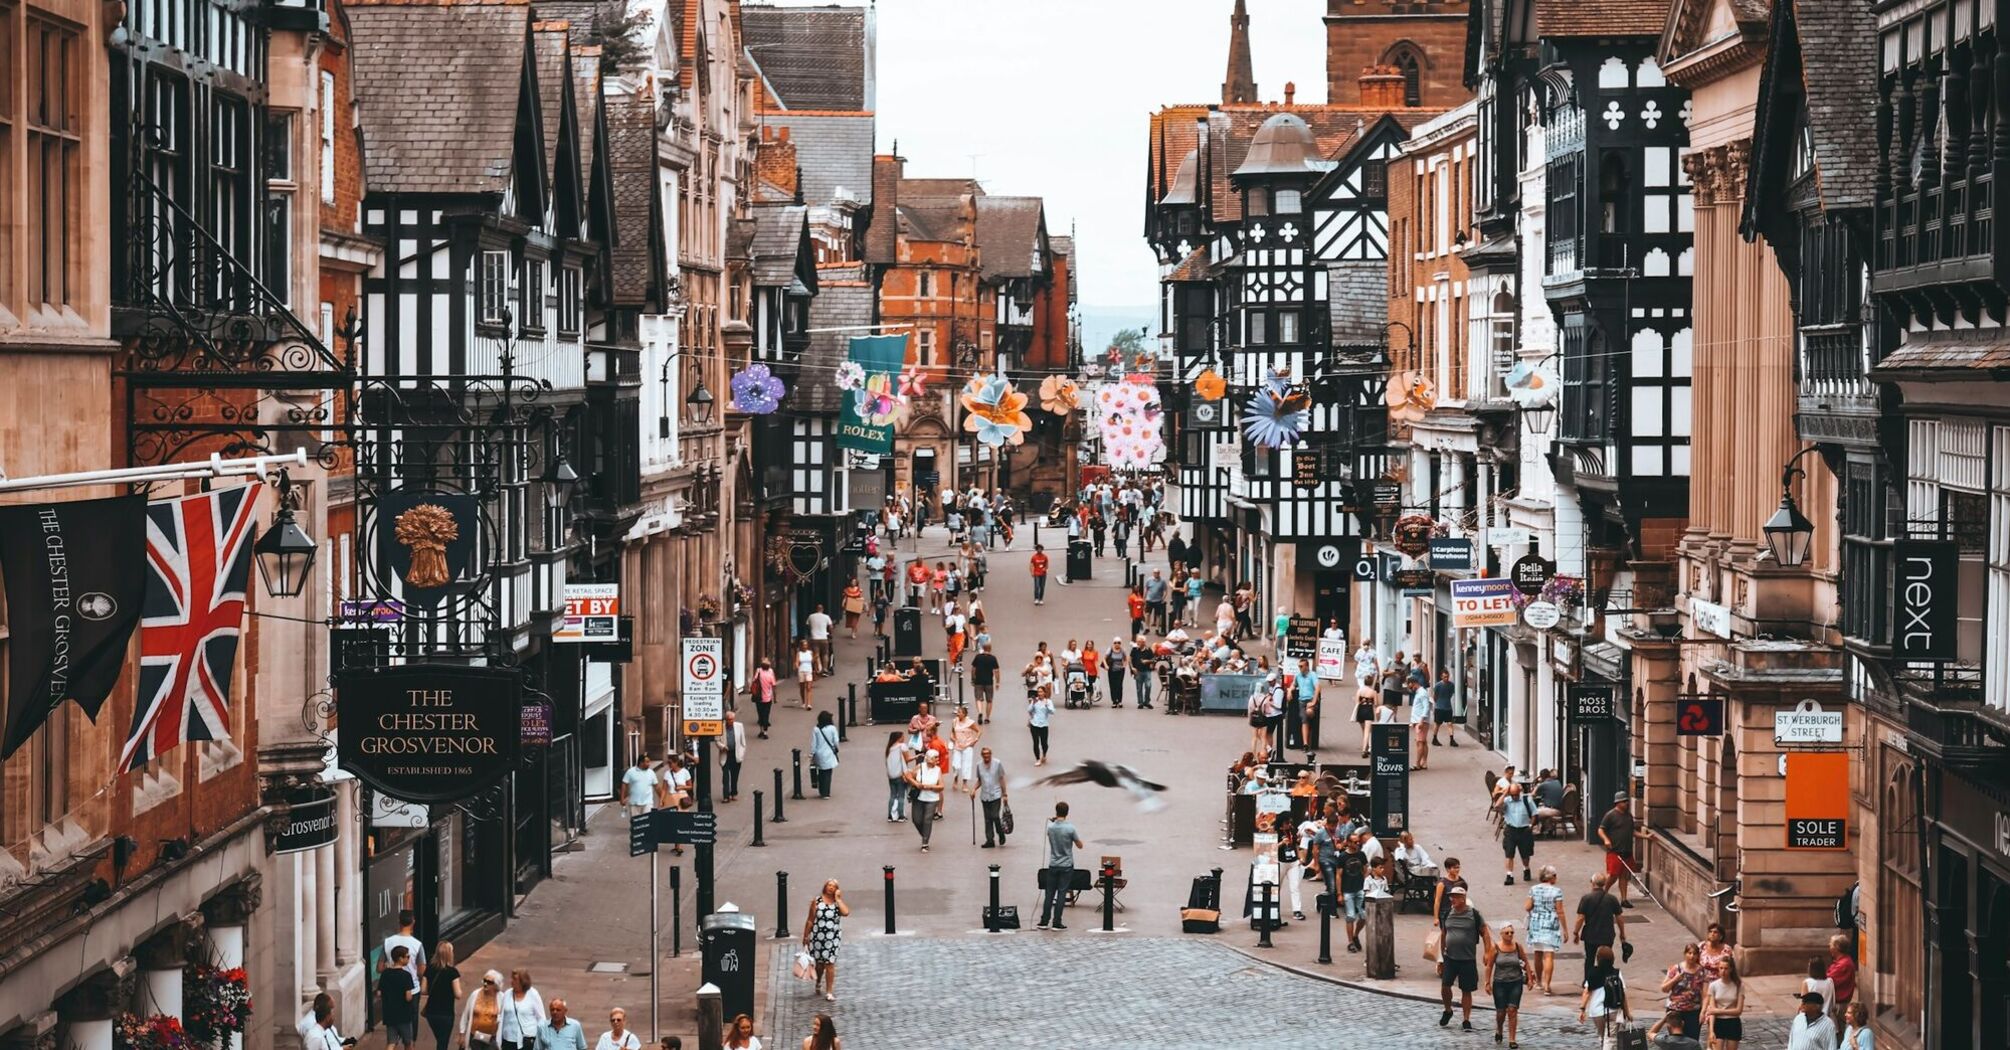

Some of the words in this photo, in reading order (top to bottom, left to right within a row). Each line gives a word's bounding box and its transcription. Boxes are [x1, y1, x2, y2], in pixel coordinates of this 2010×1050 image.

[843, 425, 886, 442] ROLEX
[38, 508, 62, 534] THE
[1435, 546, 1468, 554] Carphone
[45, 535, 70, 611] CHESTER
[1519, 563, 1543, 572] Bella
[1456, 583, 1510, 597] kenneymoore
[564, 599, 584, 615] ET
[590, 599, 614, 615] BY
[1456, 600, 1478, 611] TO
[1483, 598, 1512, 610] LET
[1904, 557, 1932, 650] next
[48, 615, 70, 715] GROSVEN
[406, 689, 453, 707] THE
[1219, 689, 1254, 699] NER
[1579, 697, 1606, 705] MOSS
[1579, 705, 1609, 714] BROS.
[379, 713, 479, 731] CHESTER
[1791, 716, 1840, 725] WERBURGH
[1791, 728, 1826, 738] STREET
[361, 737, 498, 754] GROSVENOR
[387, 766, 452, 775] ESTABLISHED
[454, 766, 473, 775] 1865
[1377, 762, 1404, 772] Rows
[1796, 821, 1837, 834] SOLE
[1995, 811, 2010, 857] ne
[1796, 837, 1836, 846] TRADER
